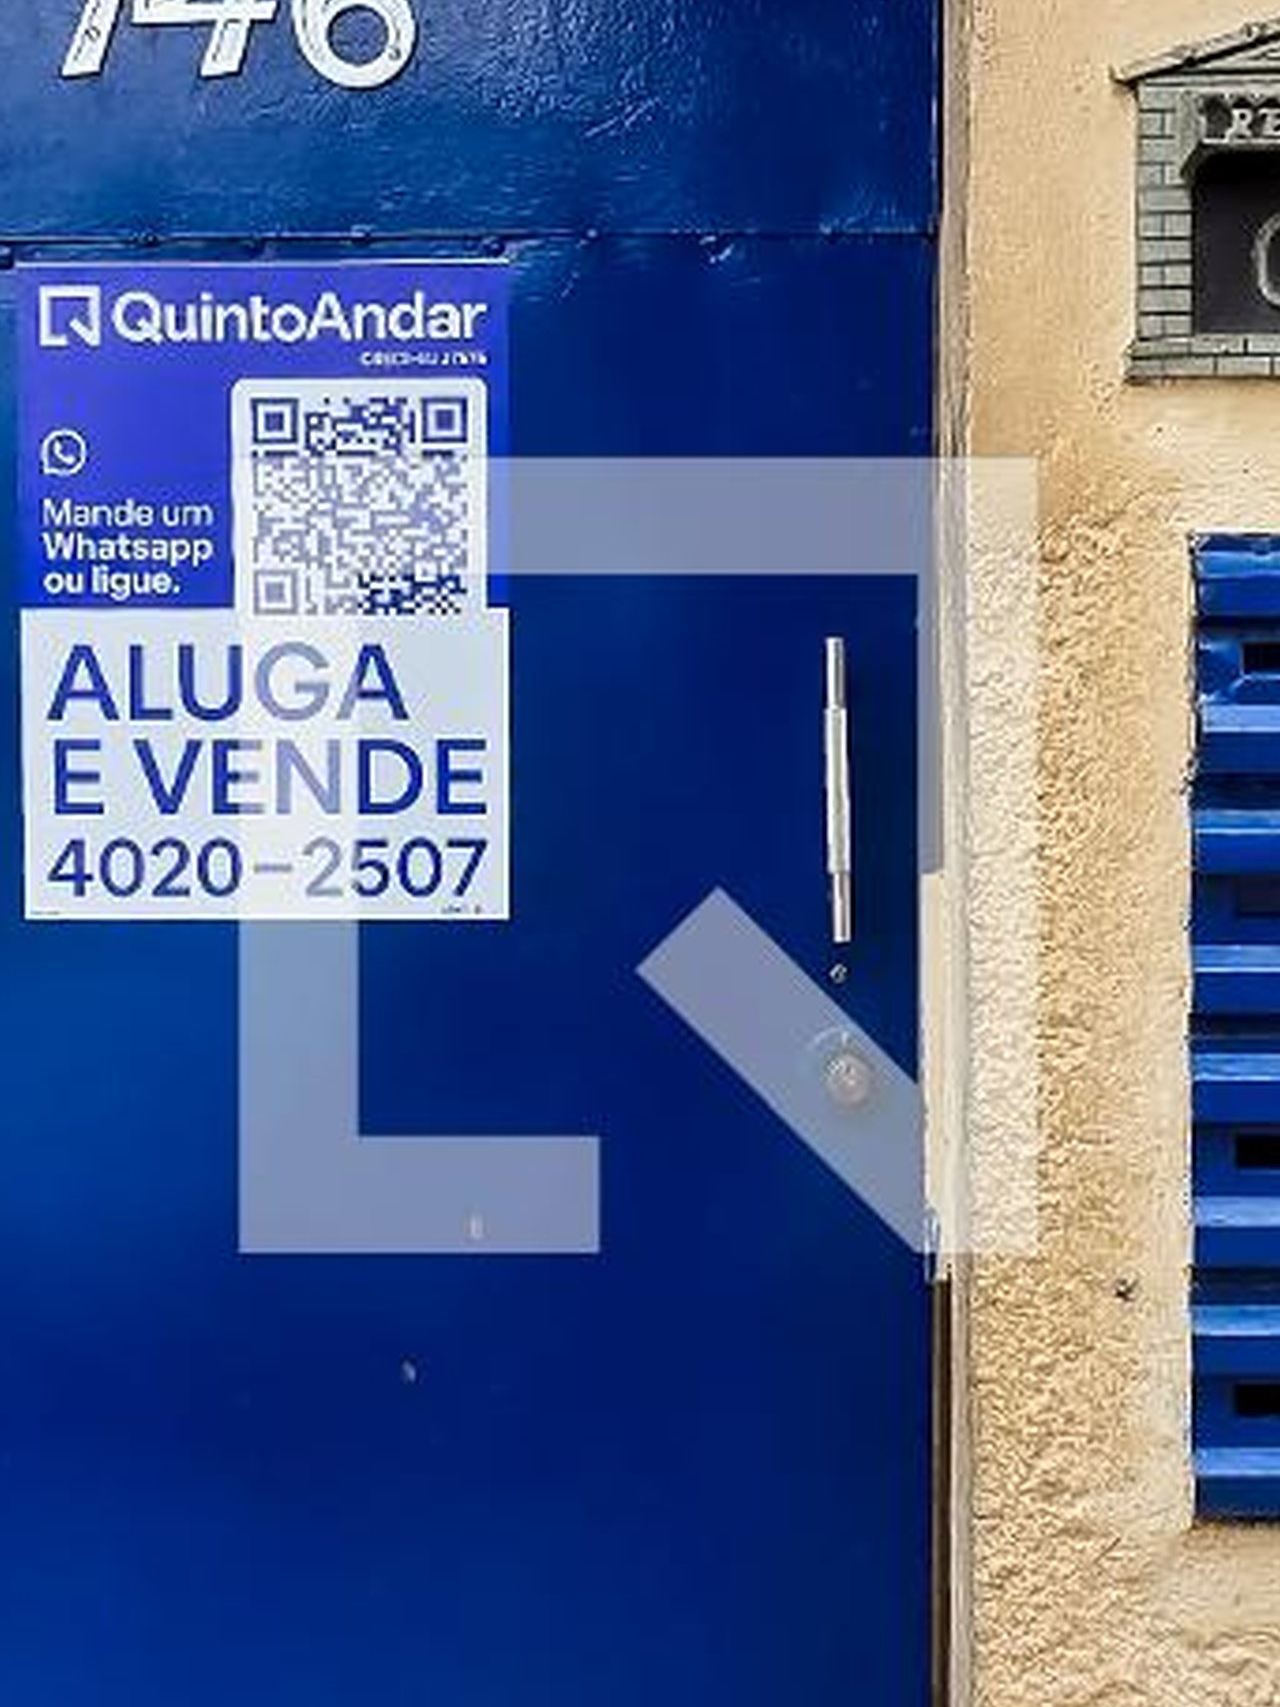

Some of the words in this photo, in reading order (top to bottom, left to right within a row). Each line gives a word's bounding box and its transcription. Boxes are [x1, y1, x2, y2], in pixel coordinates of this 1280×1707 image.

[112, 291, 487, 344] QuintoAndar
[41, 498, 153, 527] Mande
[161, 506, 213, 527] um
[41, 532, 214, 566] Whatsapp
[43, 576, 84, 593] ou
[91, 565, 181, 600] ligue.
[46, 642, 409, 722] ALUGA
[54, 739, 105, 816] E
[134, 739, 488, 816] VENDE
[47, 837, 488, 899] 4020-2507
